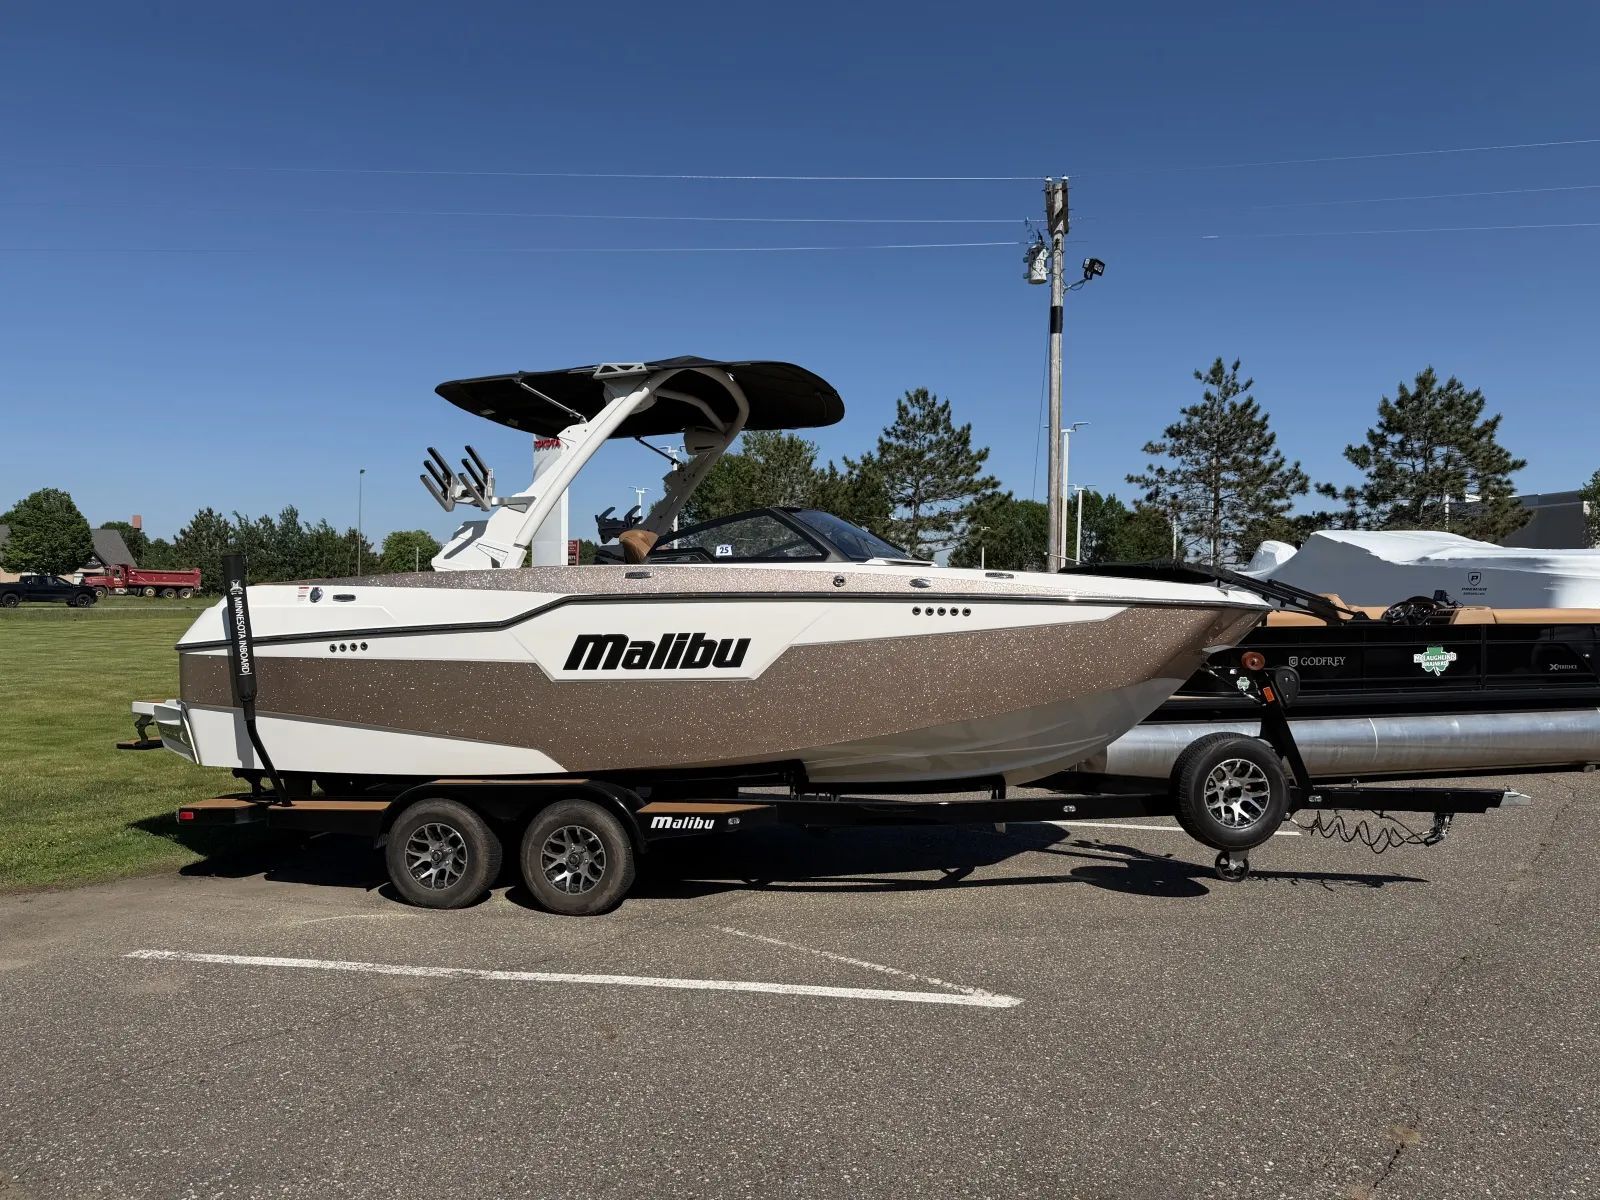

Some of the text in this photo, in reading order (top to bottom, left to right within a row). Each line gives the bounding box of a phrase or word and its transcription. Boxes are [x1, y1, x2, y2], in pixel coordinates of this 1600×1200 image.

[719, 546, 730, 554] 25
[233, 596, 250, 674] MINNESOTA INBOARD
[562, 632, 752, 671] Malibu
[1300, 656, 1346, 667] GODFREY
[650, 816, 715, 830] Malibu
